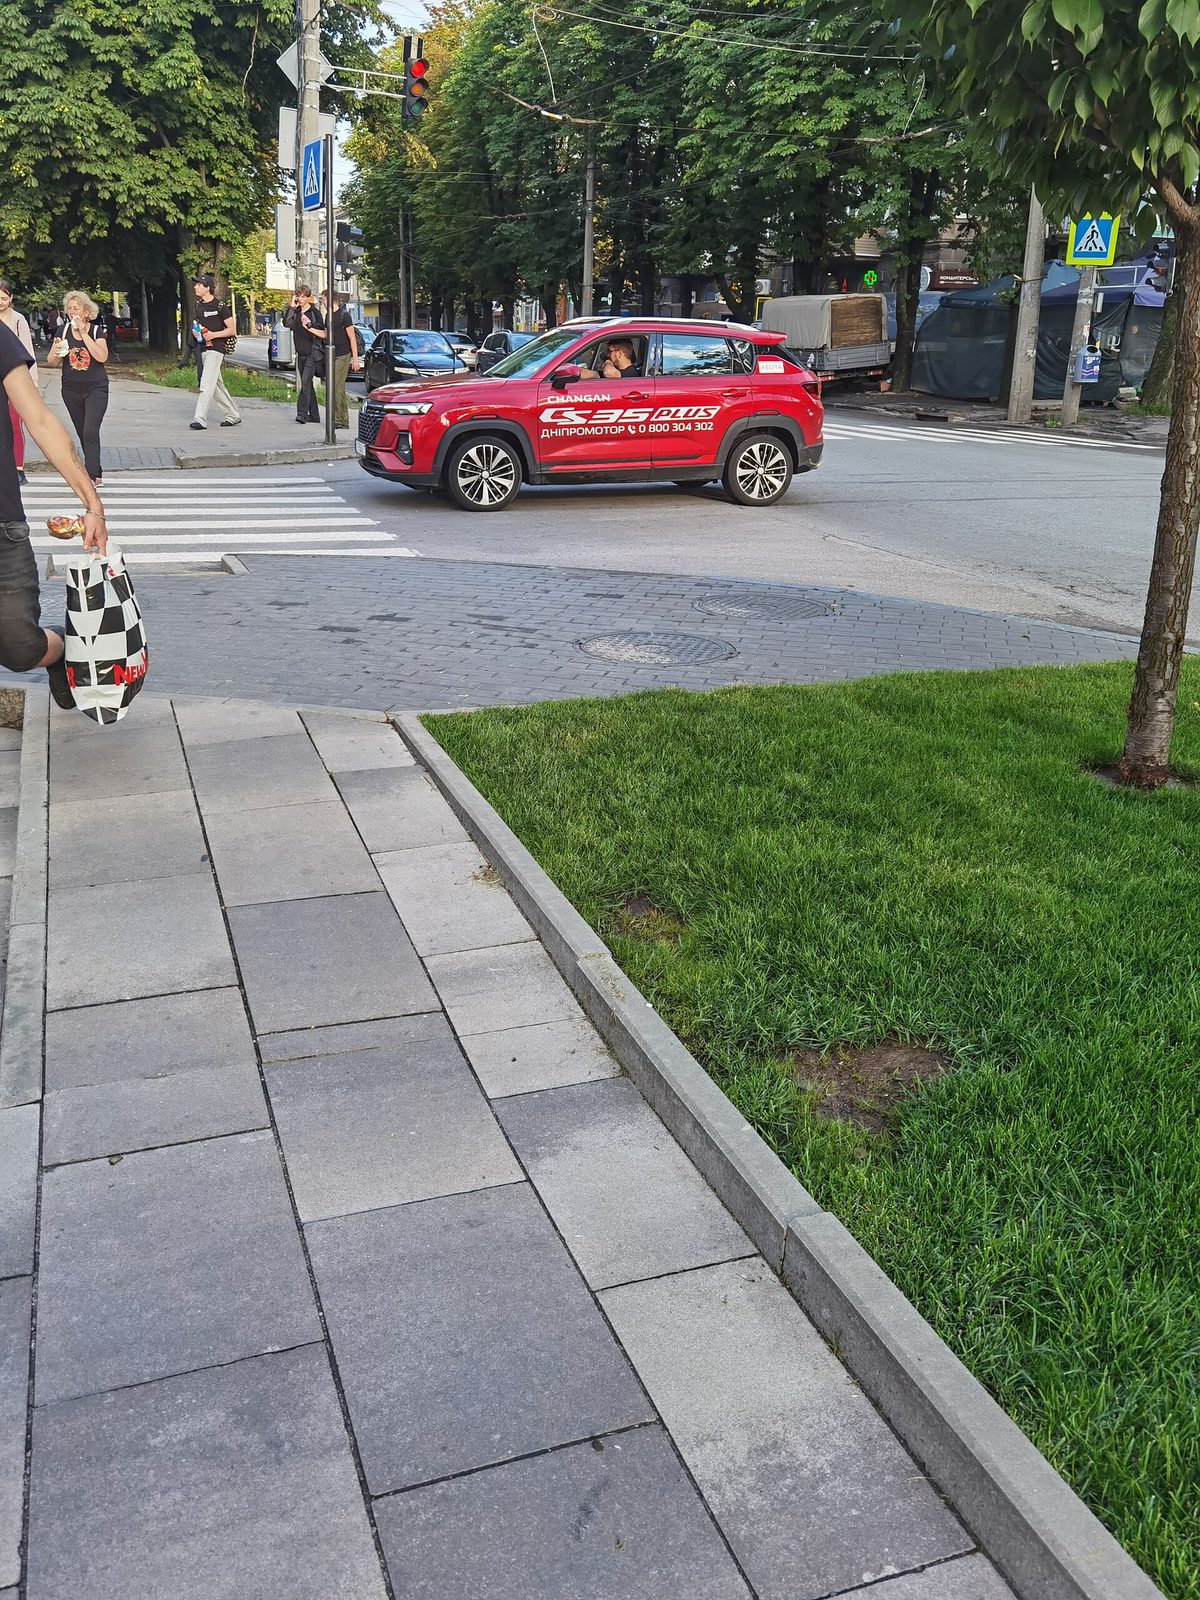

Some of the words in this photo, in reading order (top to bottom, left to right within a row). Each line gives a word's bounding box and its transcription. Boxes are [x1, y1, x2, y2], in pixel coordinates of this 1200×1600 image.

[547, 394, 611, 403] CHANGAN
[539, 407, 654, 425] CS35
[653, 407, 717, 420] PLUS
[541, 426, 625, 438] ДНІПРОМОТОР
[638, 425, 647, 433] 0
[649, 424, 669, 433] 800
[672, 423, 692, 432] 304
[694, 422, 714, 431] 302
